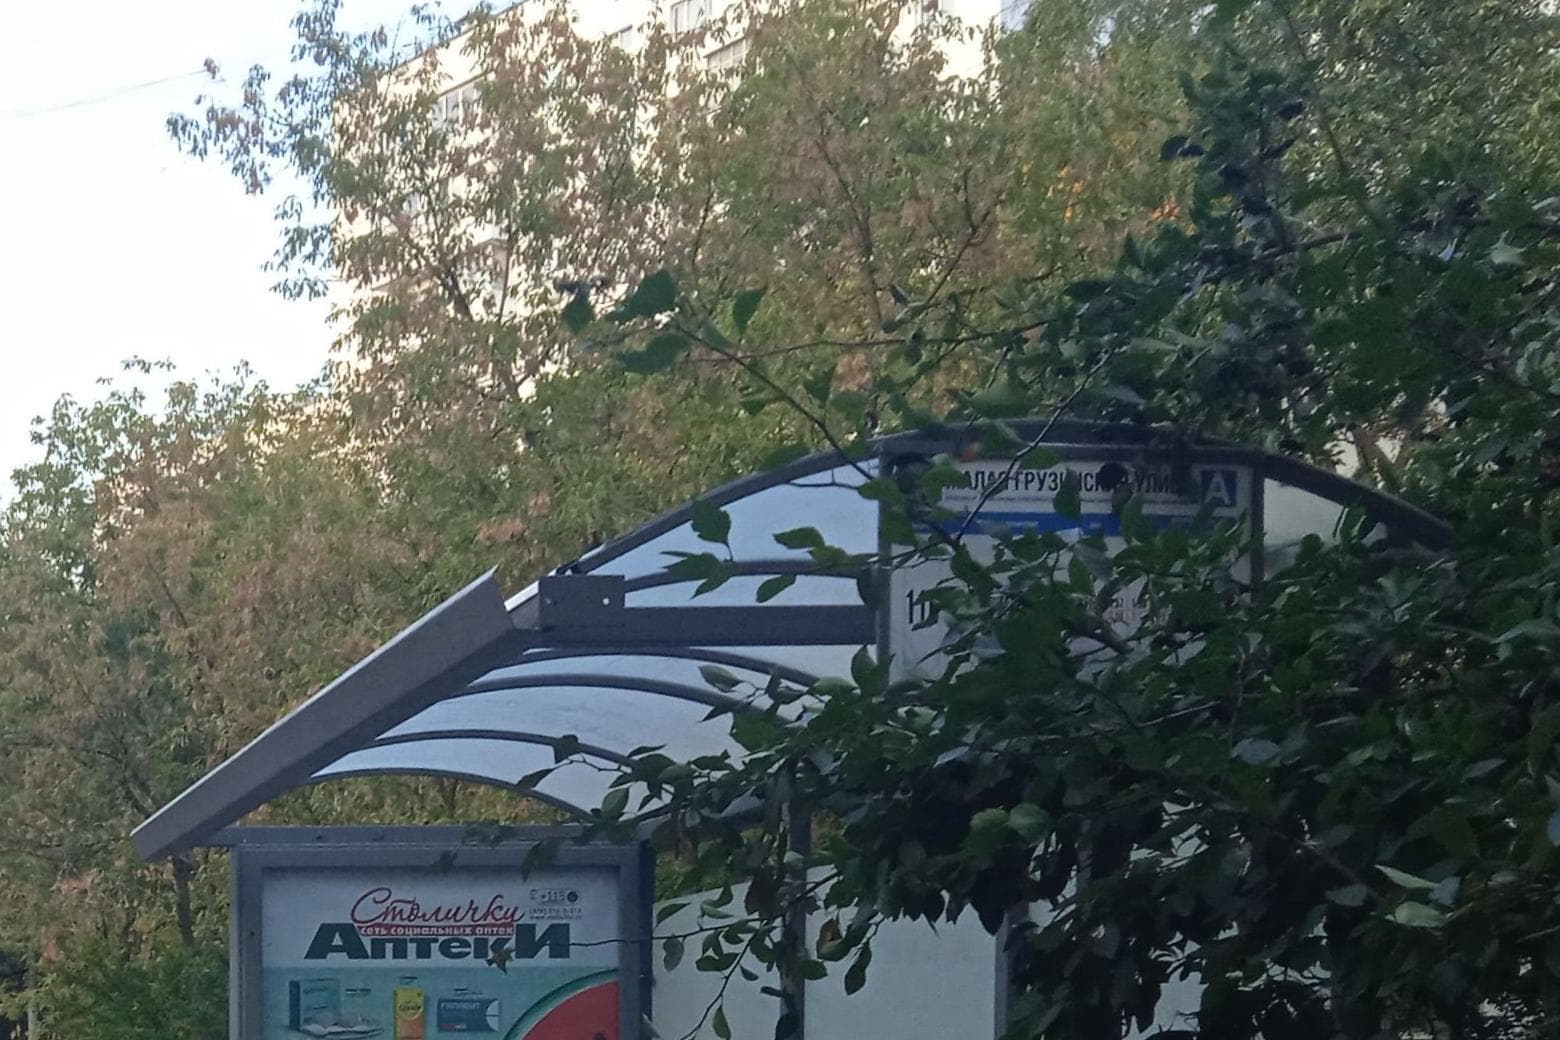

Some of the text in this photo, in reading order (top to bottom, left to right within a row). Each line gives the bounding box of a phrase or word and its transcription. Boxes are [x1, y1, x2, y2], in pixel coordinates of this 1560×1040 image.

[350, 887, 525, 924] Столички
[360, 926, 514, 937] сеть социальных аптек
